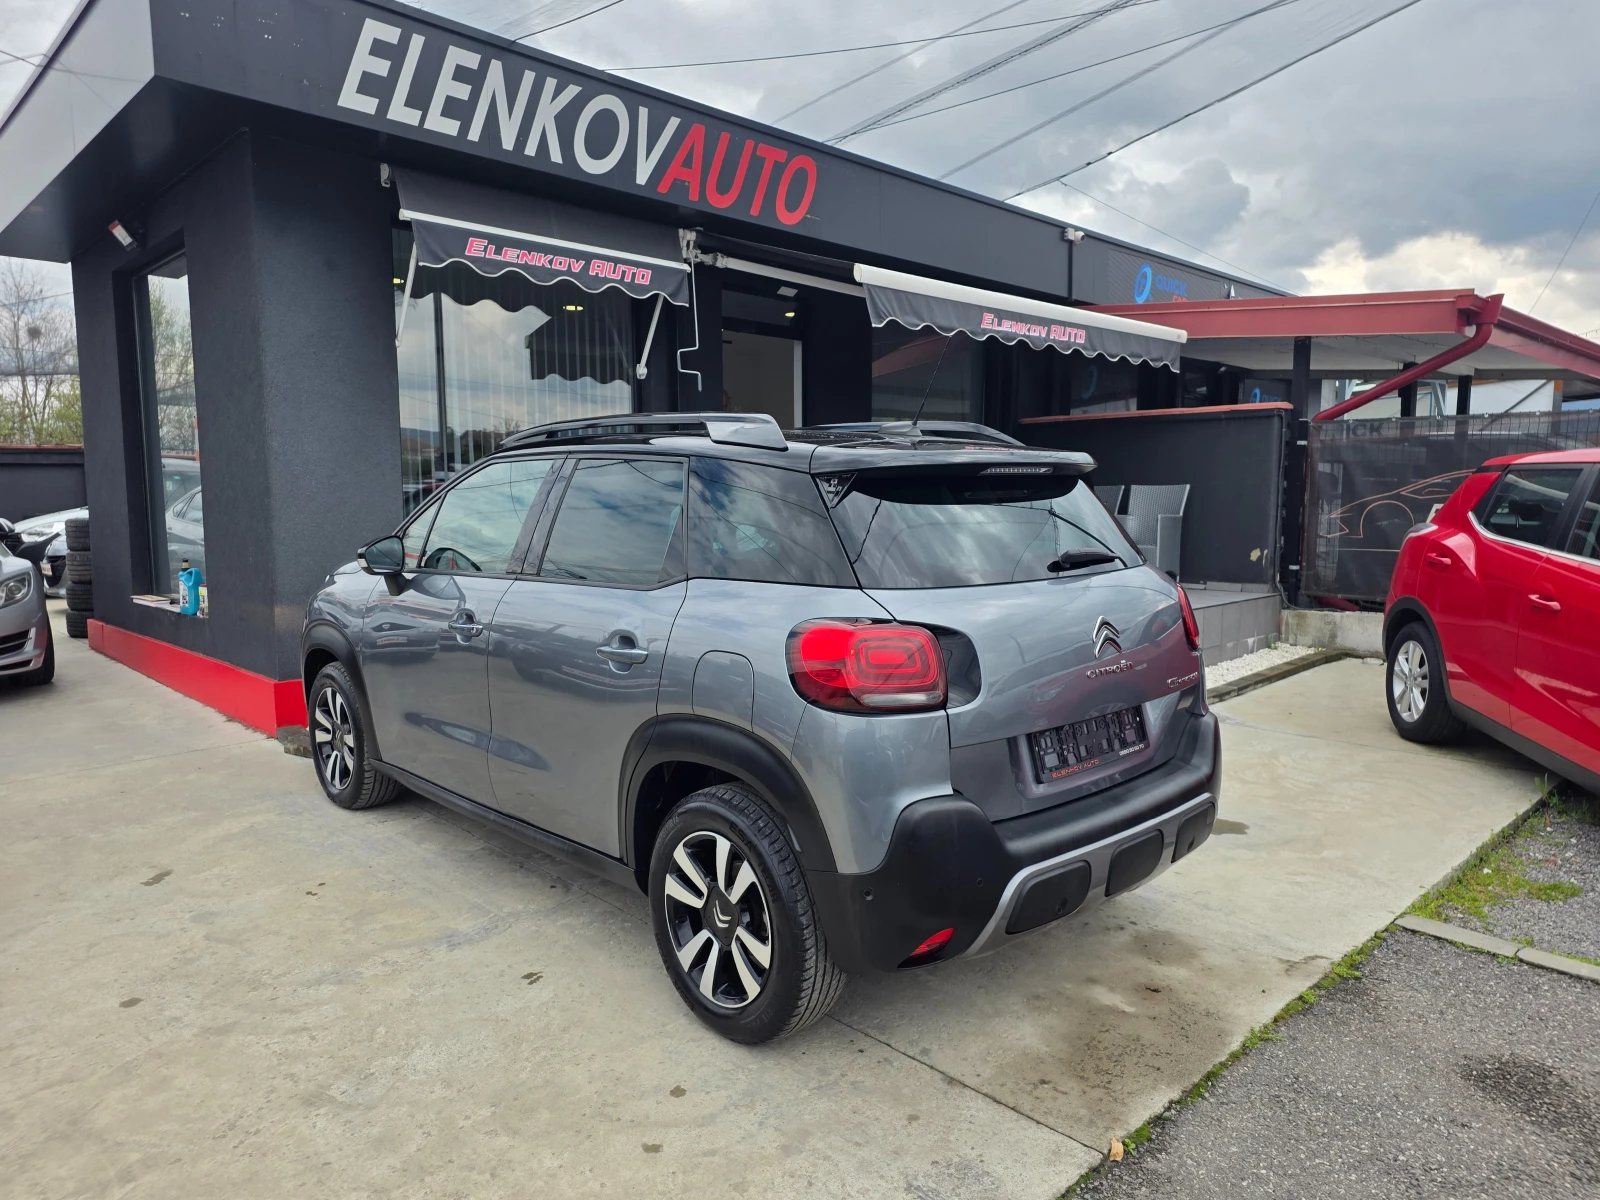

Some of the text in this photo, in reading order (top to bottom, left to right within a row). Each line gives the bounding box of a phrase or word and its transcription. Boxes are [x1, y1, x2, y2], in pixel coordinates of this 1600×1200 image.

[465, 237, 652, 285] ELENKOV AUTO
[980, 312, 1086, 343] ELENKOV AUTO
